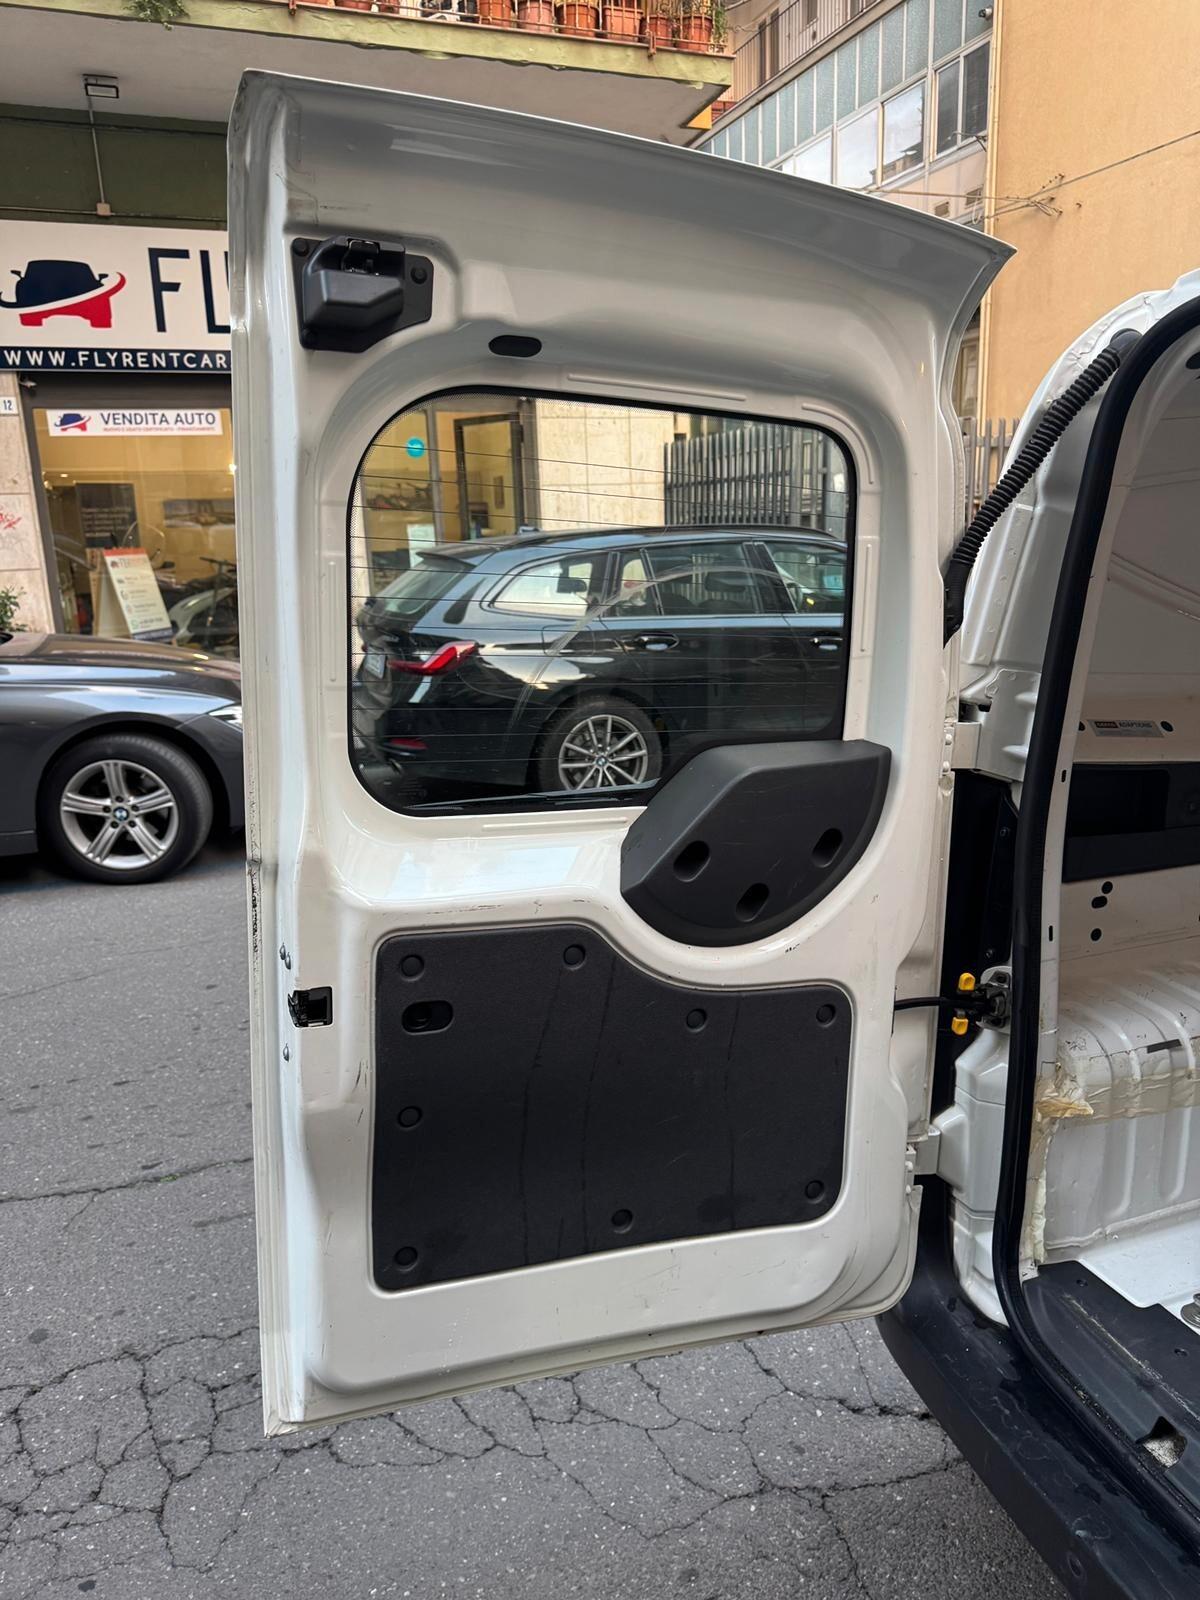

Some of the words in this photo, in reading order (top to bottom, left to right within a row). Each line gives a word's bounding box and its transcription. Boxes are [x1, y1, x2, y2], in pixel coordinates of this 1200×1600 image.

[3, 400, 12, 410] 12
[100, 412, 169, 425] VENDITA
[174, 412, 216, 425] AUTO
